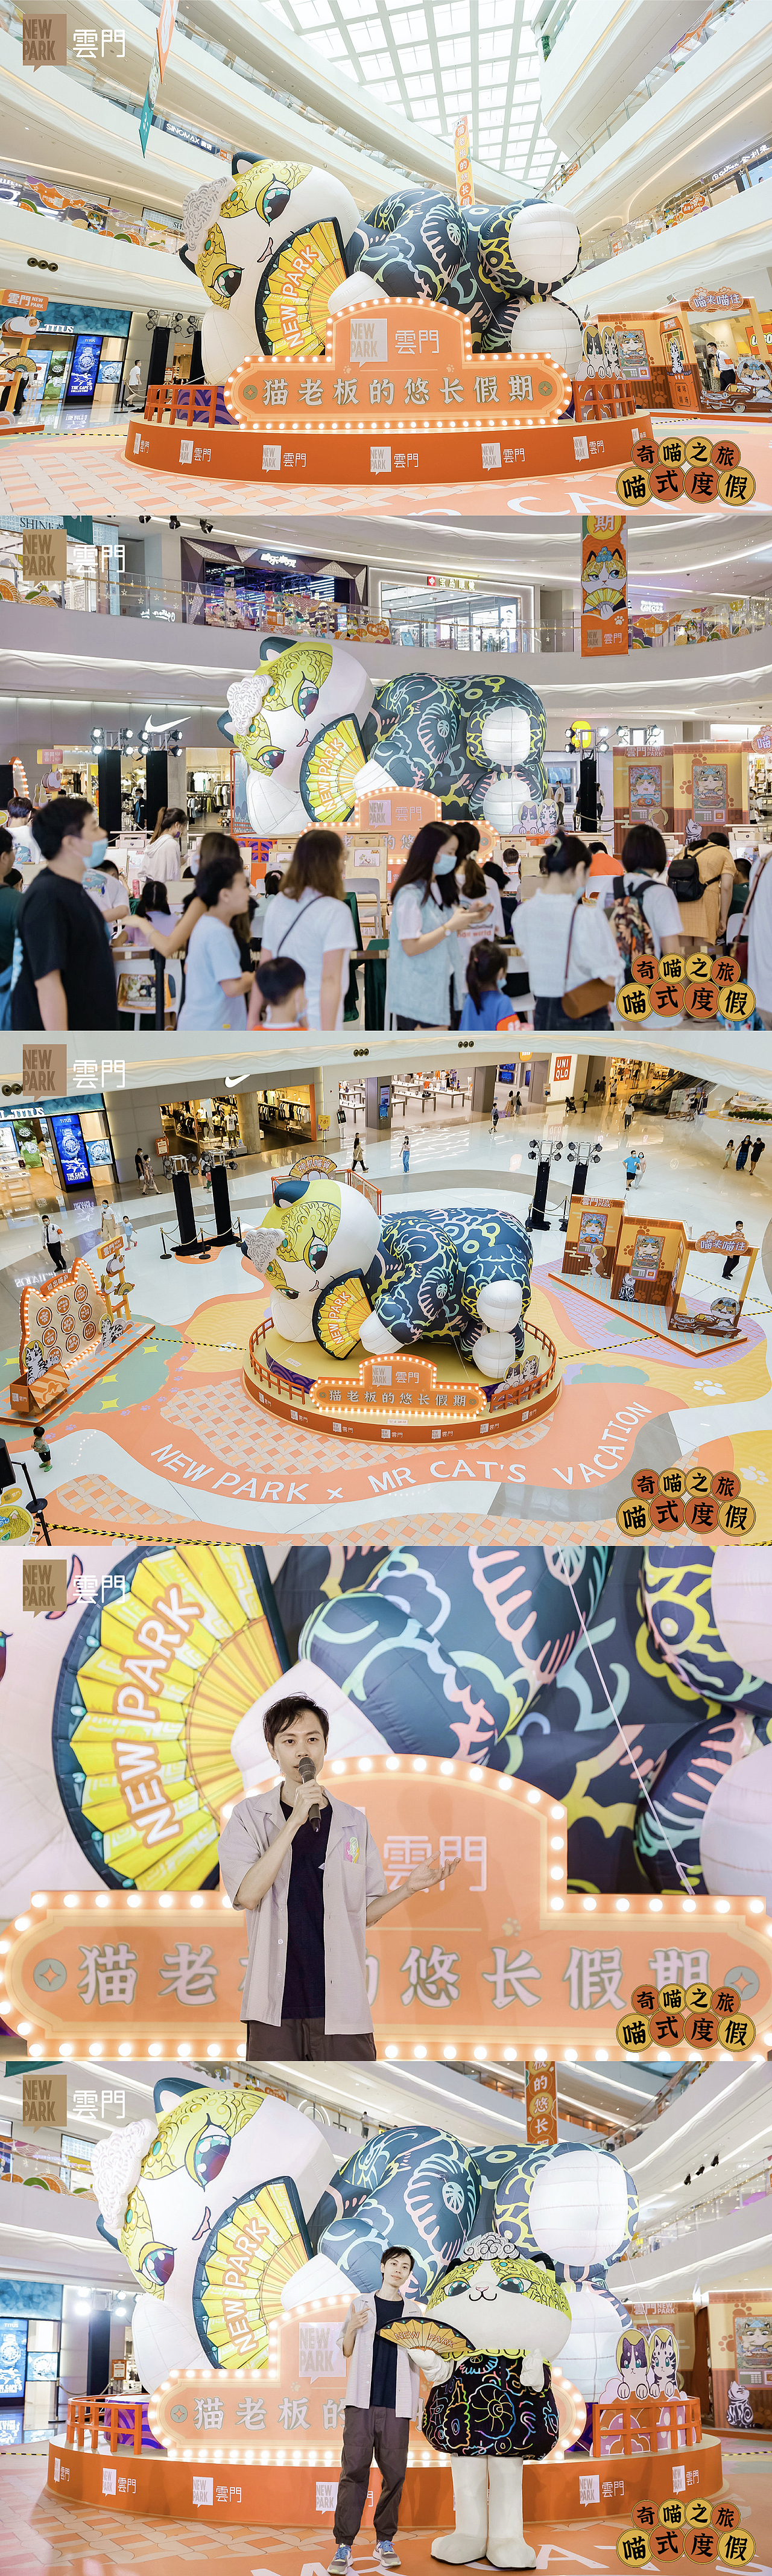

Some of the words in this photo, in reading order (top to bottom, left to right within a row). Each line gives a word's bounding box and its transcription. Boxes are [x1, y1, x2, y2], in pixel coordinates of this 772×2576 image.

[166, 123, 200, 145] SINOMAX
[282, 245, 318, 299] PARK
[7, 293, 31, 307] 雲門
[693, 294, 741, 308] 喵来喵往
[280, 304, 305, 349] NEW
[350, 323, 375, 340] NEW
[395, 330, 439, 355] 雲門
[751, 334, 772, 346] LO
[350, 340, 378, 357] PARK
[262, 375, 534, 407] 猫老板的悠长假期
[263, 448, 275, 457] NEW
[482, 446, 495, 455] NEW
[589, 440, 604, 454] 雲門
[194, 448, 211, 462] 雲門
[283, 453, 306, 468] 雲門
[370, 450, 384, 459] NEW
[394, 453, 419, 468] 雲門
[482, 456, 497, 465] PARK
[503, 448, 525, 463] 雲門
[262, 458, 276, 467] PARK
[370, 460, 386, 469] PARK
[439, 577, 475, 591] 宝岛眼镜
[604, 633, 622, 644] 雲門
[318, 737, 344, 776] PARK
[627, 746, 646, 757] 雲門
[318, 781, 337, 812] NEW
[369, 803, 384, 812] NEW
[396, 807, 422, 821] 雲門
[369, 813, 385, 823] PARK
[557, 1058, 569, 1069] UNI
[555, 1069, 569, 1079] QLO
[297, 1159, 331, 1172] 神机喵算
[582, 1197, 598, 1207] 雲門
[103, 1244, 115, 1257] 雲門
[701, 1239, 746, 1251] 喵来喵往
[47, 1274, 69, 1291] 初出喵庐
[329, 1291, 352, 1315] PARK
[327, 1317, 344, 1345] NEW
[395, 1372, 419, 1384] 雲門
[329, 1390, 466, 1407] 猫老板的悠长假期
[151, 1443, 214, 1482] NEW
[212, 1472, 309, 1502] PARK
[367, 1467, 417, 1493] MR
[429, 1459, 527, 1483] CAT'S
[552, 1401, 653, 1485] VACATION
[115, 1586, 203, 1720] PARK
[115, 1740, 183, 1846] NEW
[223, 2218, 270, 2290] PARK
[633, 2303, 657, 2315] 雲門
[222, 2298, 259, 2356] NEW
[299, 2327, 331, 2349] NEW
[394, 2331, 420, 2340] NEW
[428, 2333, 454, 2349] PARK
[299, 2350, 334, 2371] PARK
[60, 2466, 70, 2481] 雲門
[103, 2470, 112, 2481] NEW
[673, 2469, 682, 2479] NEW
[686, 2470, 699, 2486] 雲門
[102, 2481, 113, 2492] PARK
[118, 2477, 136, 2493] 雲門
[193, 2479, 206, 2489] NEW
[316, 2485, 332, 2496] NEW
[580, 2479, 593, 2491] NEW
[603, 2480, 624, 2497] 雲門
[673, 2479, 683, 2490] PARK
[193, 2492, 208, 2502] PARK
[215, 2486, 241, 2503] 雲門
[580, 2492, 595, 2502] PARK
[316, 2497, 334, 2508] PARK
